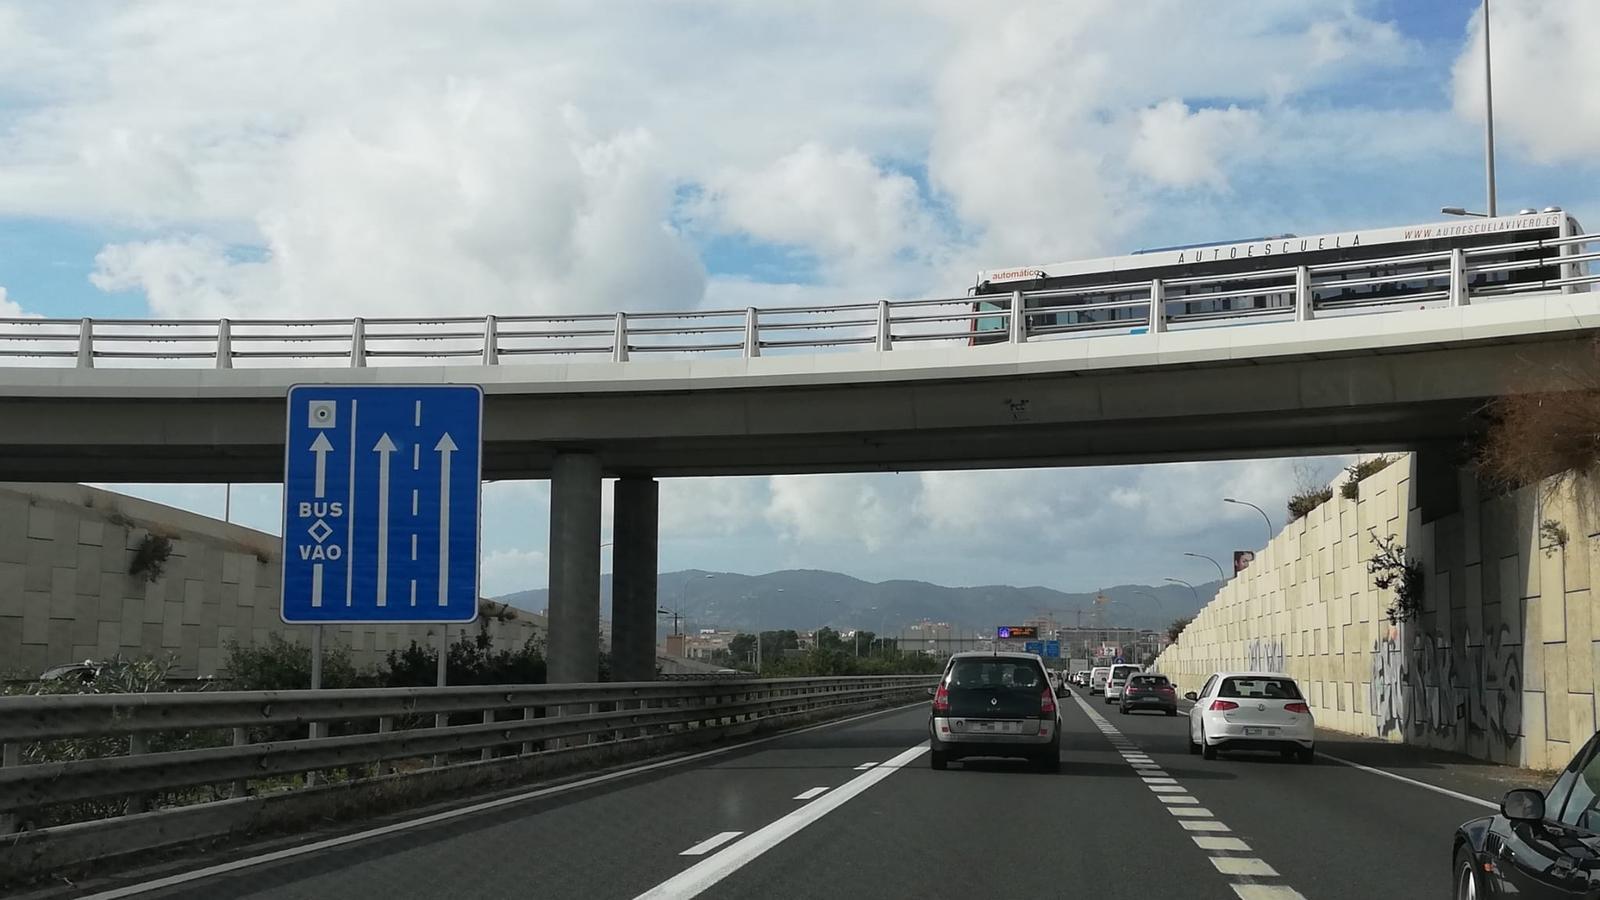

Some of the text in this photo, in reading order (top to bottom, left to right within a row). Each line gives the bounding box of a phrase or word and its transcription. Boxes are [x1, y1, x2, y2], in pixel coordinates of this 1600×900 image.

[1178, 234, 1360, 264] AUTOESCUELA
[299, 502, 343, 517] BUS
[299, 545, 341, 560] VAO
